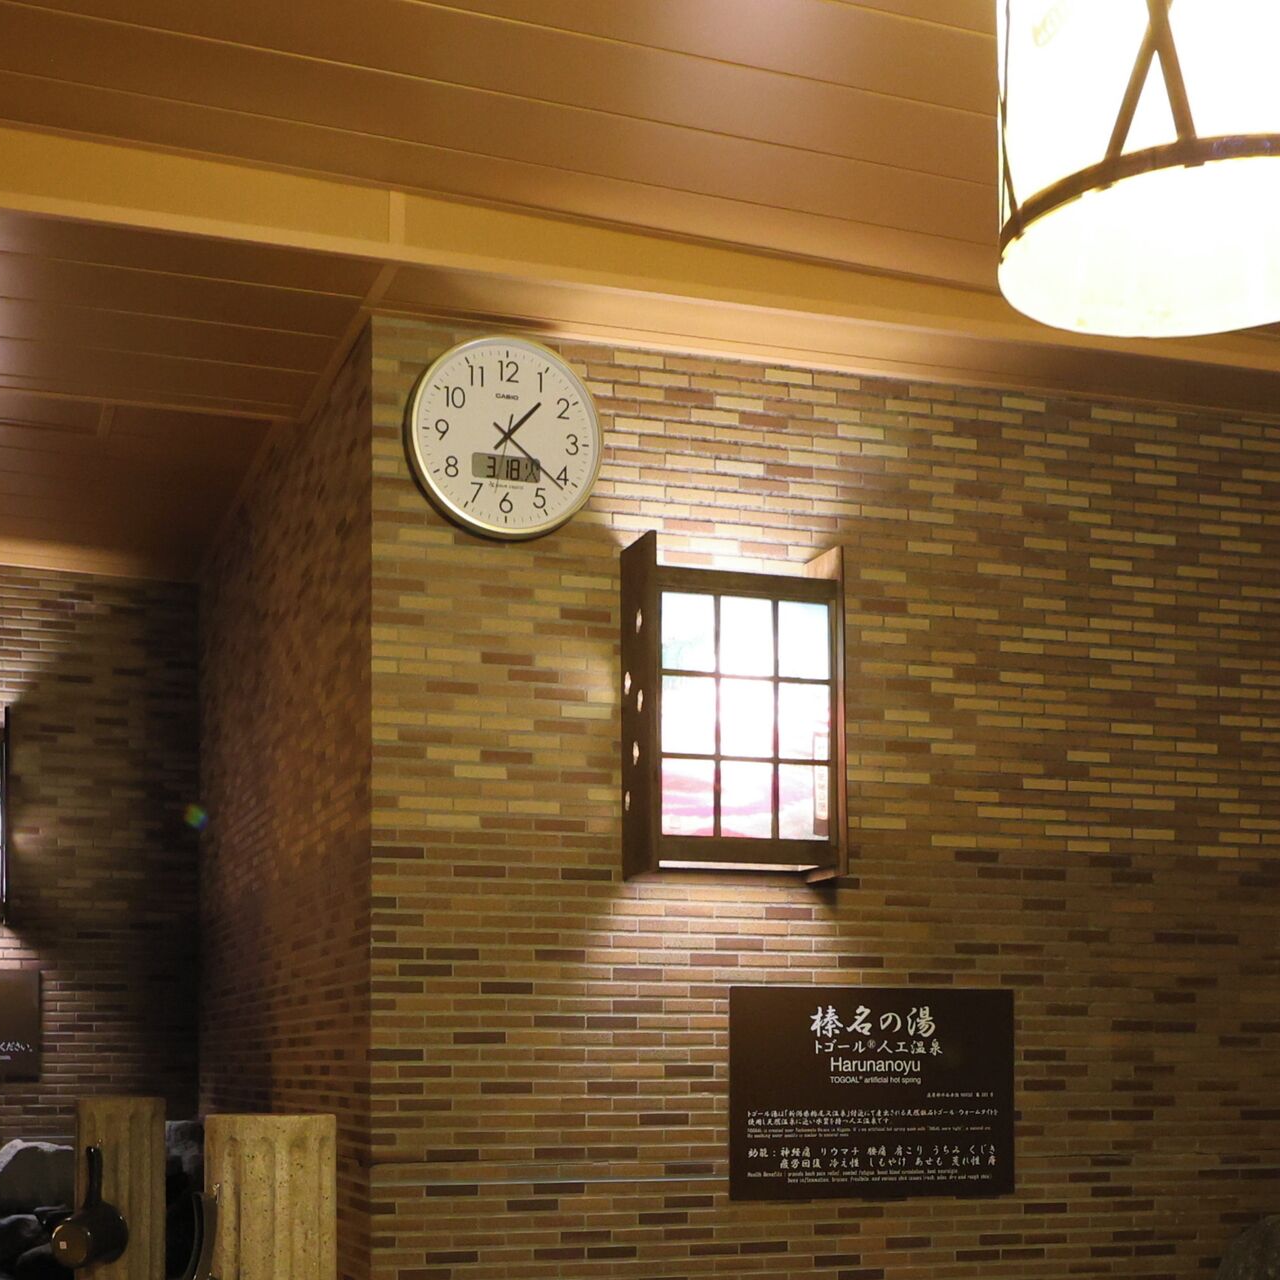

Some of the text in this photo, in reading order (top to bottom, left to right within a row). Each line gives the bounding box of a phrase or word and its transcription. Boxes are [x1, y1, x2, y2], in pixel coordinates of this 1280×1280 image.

[469, 365, 485, 387] 11
[498, 360, 520, 384] 12
[537, 372, 544, 393] 1
[444, 386, 466, 409] 10
[495, 393, 520, 401] CASIO
[556, 399, 570, 420] 2
[435, 419, 450, 441] 9
[565, 434, 579, 456] 3
[444, 456, 459, 478] 8
[556, 466, 569, 486] 4
[471, 482, 483, 504] 7
[499, 493, 513, 514] 6
[533, 488, 547, 509] 5
[809, 1005, 937, 1038] 榛名の湯
[830, 1057, 921, 1075] Harunanoyu
[864, 1076, 888, 1084] artificial
[889, 1076, 900, 1084] hot
[901, 1076, 922, 1086] spring
[821, 1146, 860, 1156] リウマチ
[867, 1146, 887, 1157] 腰痛
[894, 1145, 923, 1156] 肩こり
[932, 1145, 961, 1155] うちみ
[969, 1144, 996, 1155] くじき
[780, 1158, 822, 1169] 疲労回復
[829, 1157, 860, 1168] 冷え性
[869, 1157, 906, 1167] しもやけ
[915, 1156, 943, 1166] あせも
[951, 1155, 981, 1167] 荒れ性
